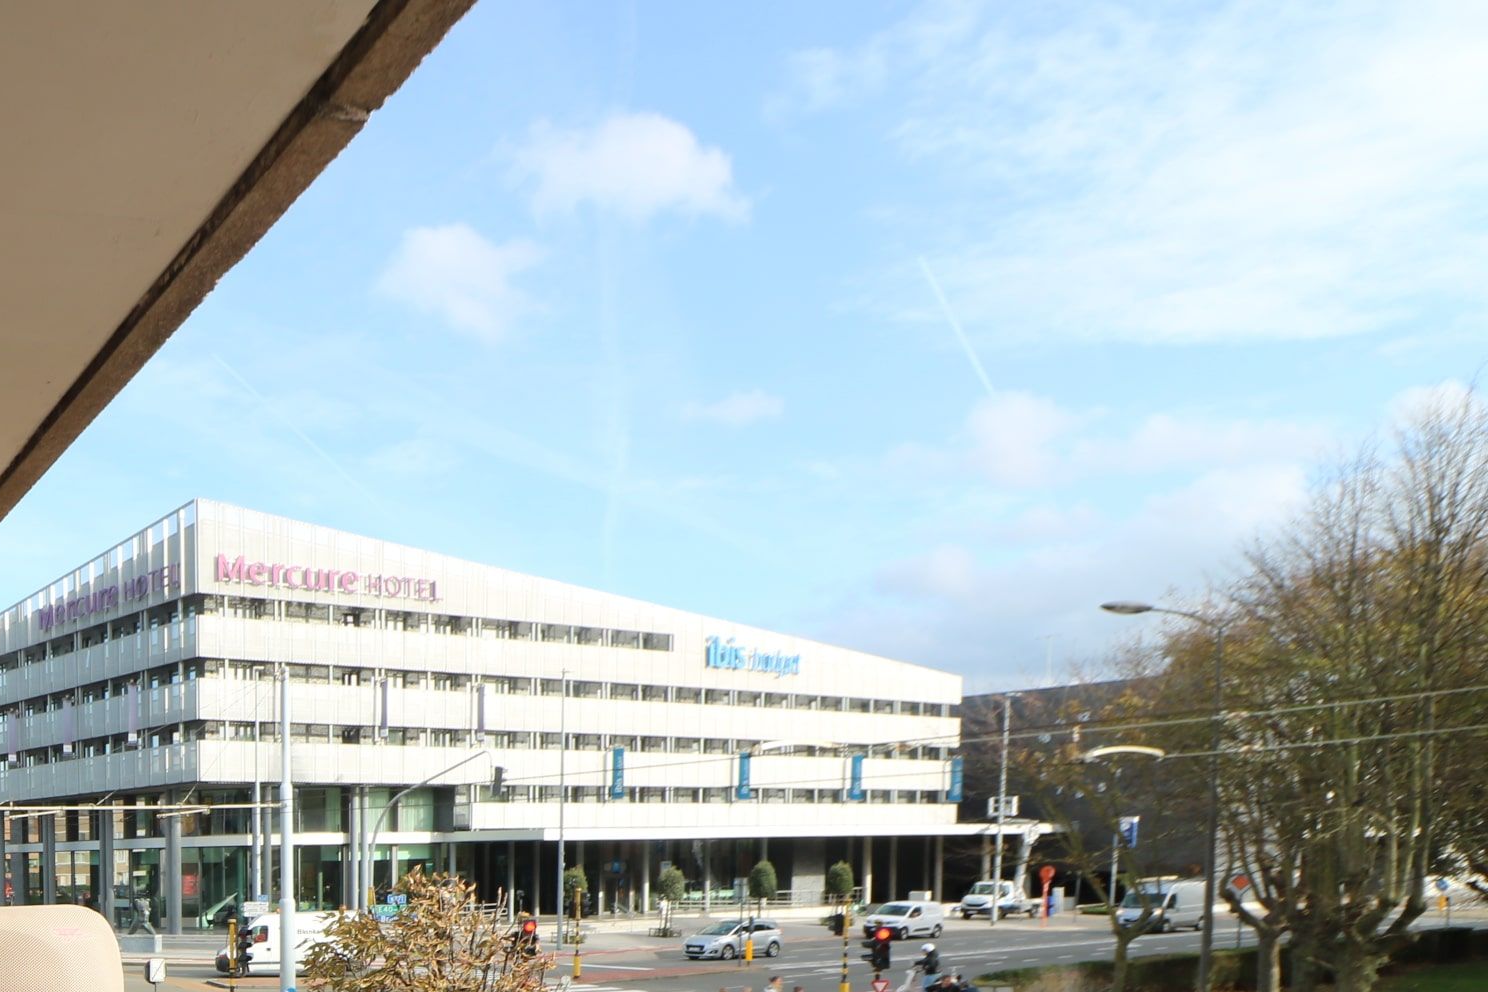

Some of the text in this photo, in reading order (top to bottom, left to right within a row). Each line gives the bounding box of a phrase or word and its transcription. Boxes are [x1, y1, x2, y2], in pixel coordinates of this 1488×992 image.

[123, 562, 182, 601] HOTEL
[214, 552, 442, 602] Mercure HOTEL
[705, 635, 745, 671] ibis
